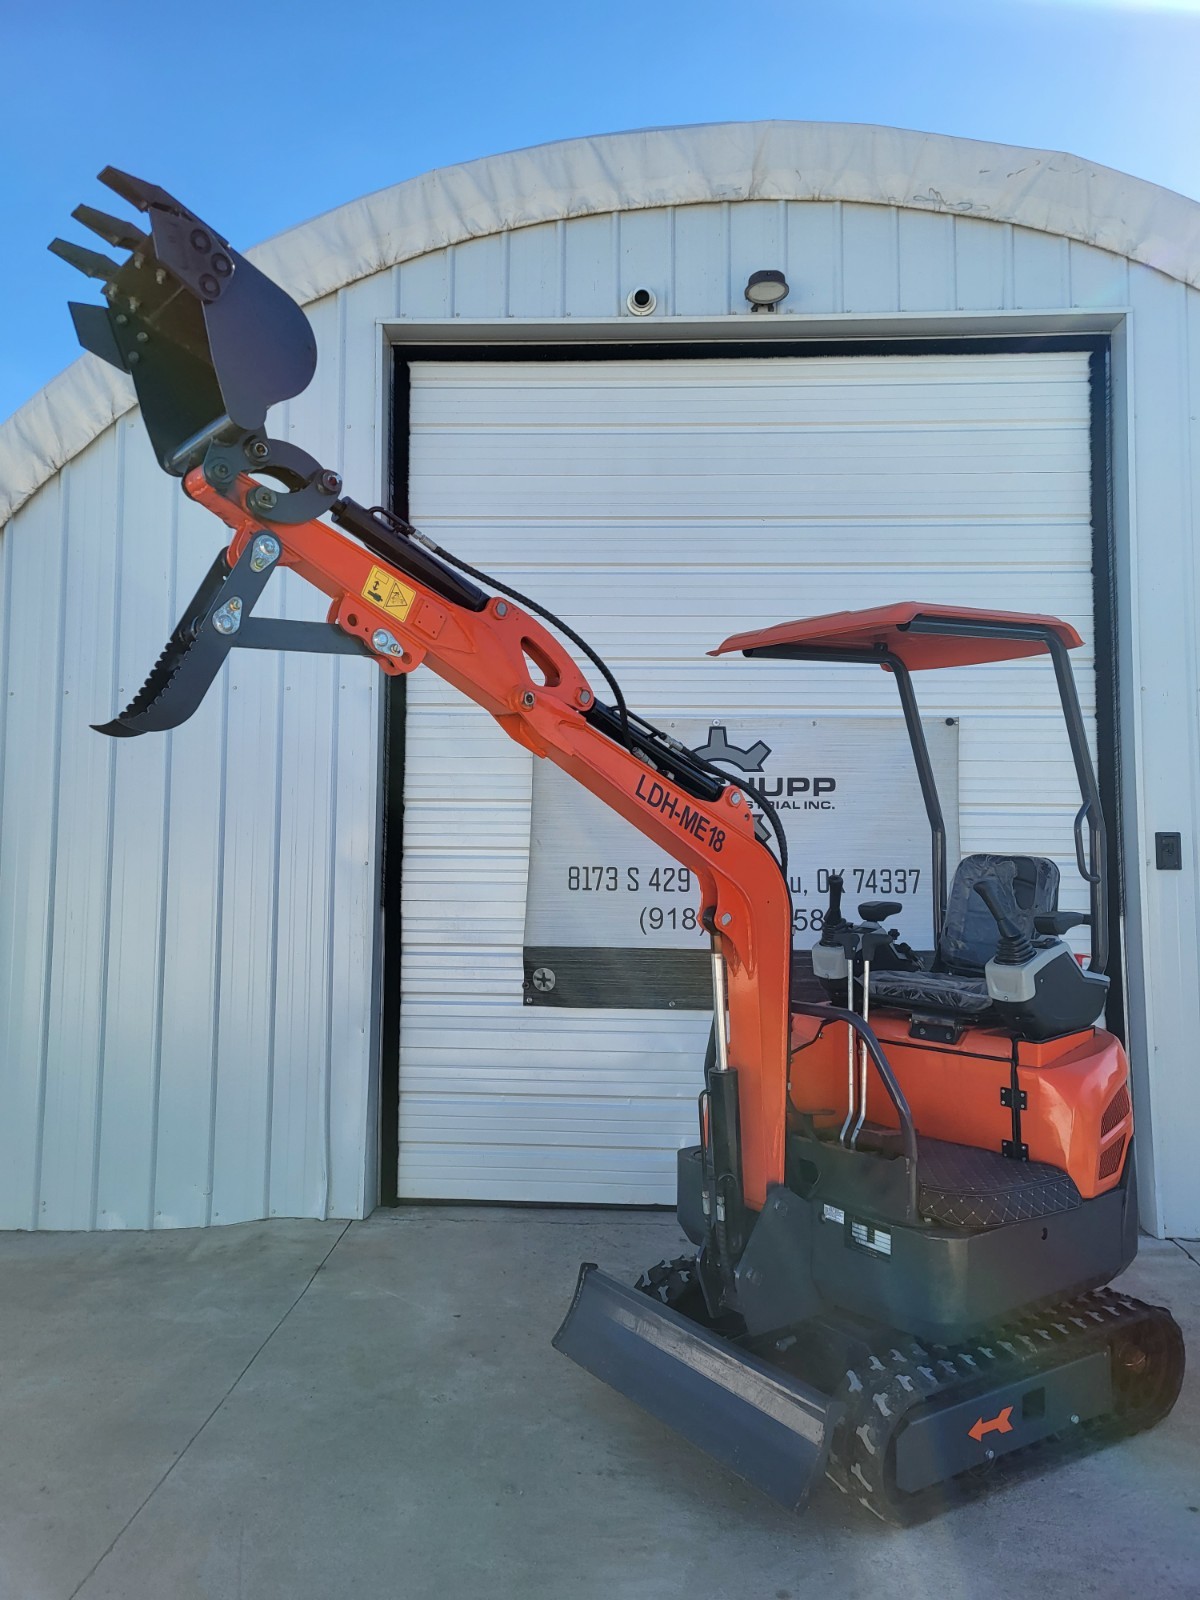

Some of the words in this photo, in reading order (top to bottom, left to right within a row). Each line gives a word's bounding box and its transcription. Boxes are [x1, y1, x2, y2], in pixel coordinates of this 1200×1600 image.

[635, 773, 726, 853] LDH-ME18
[804, 801, 836, 810] INC.
[568, 866, 618, 891] 8173
[627, 867, 639, 892] S
[648, 867, 691, 893] 429
[853, 868, 921, 894] 74337
[640, 906, 705, 936] (918
